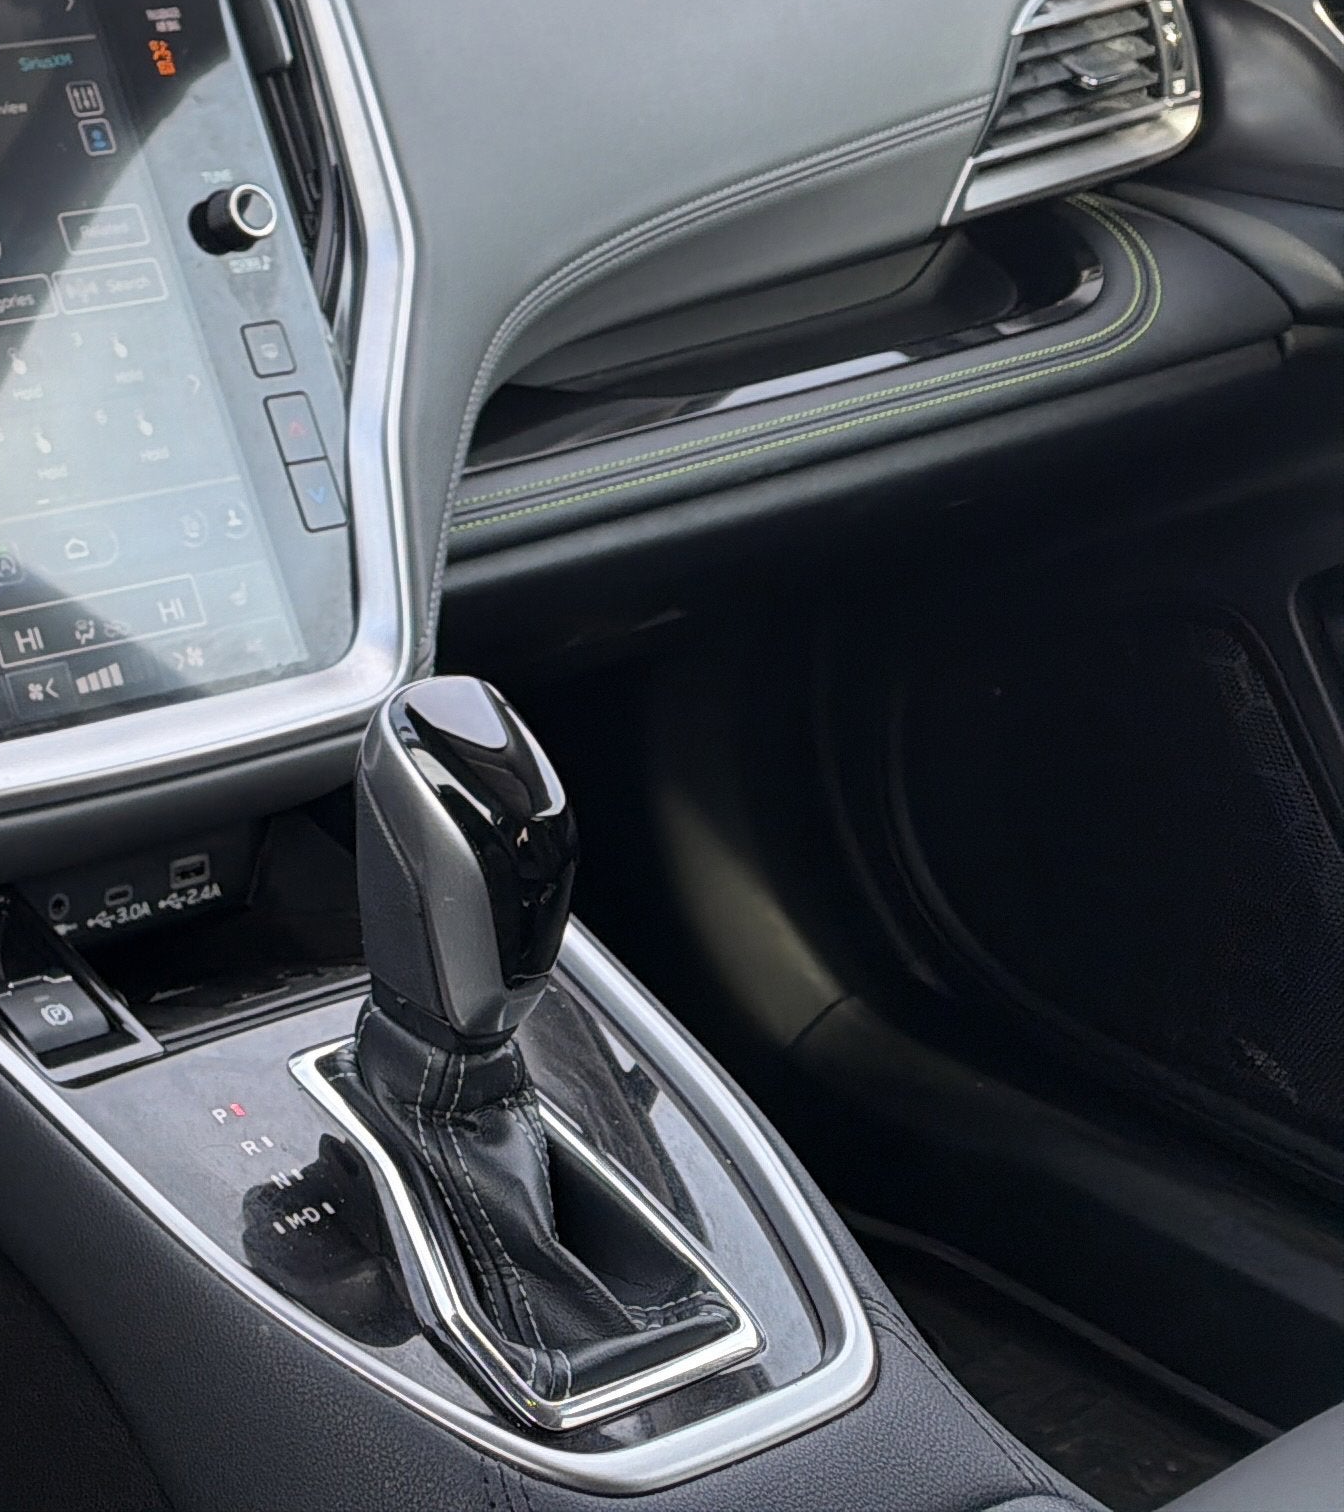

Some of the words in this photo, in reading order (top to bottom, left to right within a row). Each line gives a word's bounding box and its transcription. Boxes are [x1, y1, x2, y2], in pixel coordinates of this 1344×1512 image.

[18, 52, 72, 72] SiriusXM
[156, 597, 186, 624] HI
[15, 626, 45, 652] HI
[184, 882, 222, 906] 2.4A
[115, 901, 152, 925] 3.0A
[211, 1107, 228, 1125] P
[240, 1139, 262, 1157] R
[270, 1170, 294, 1190] N
